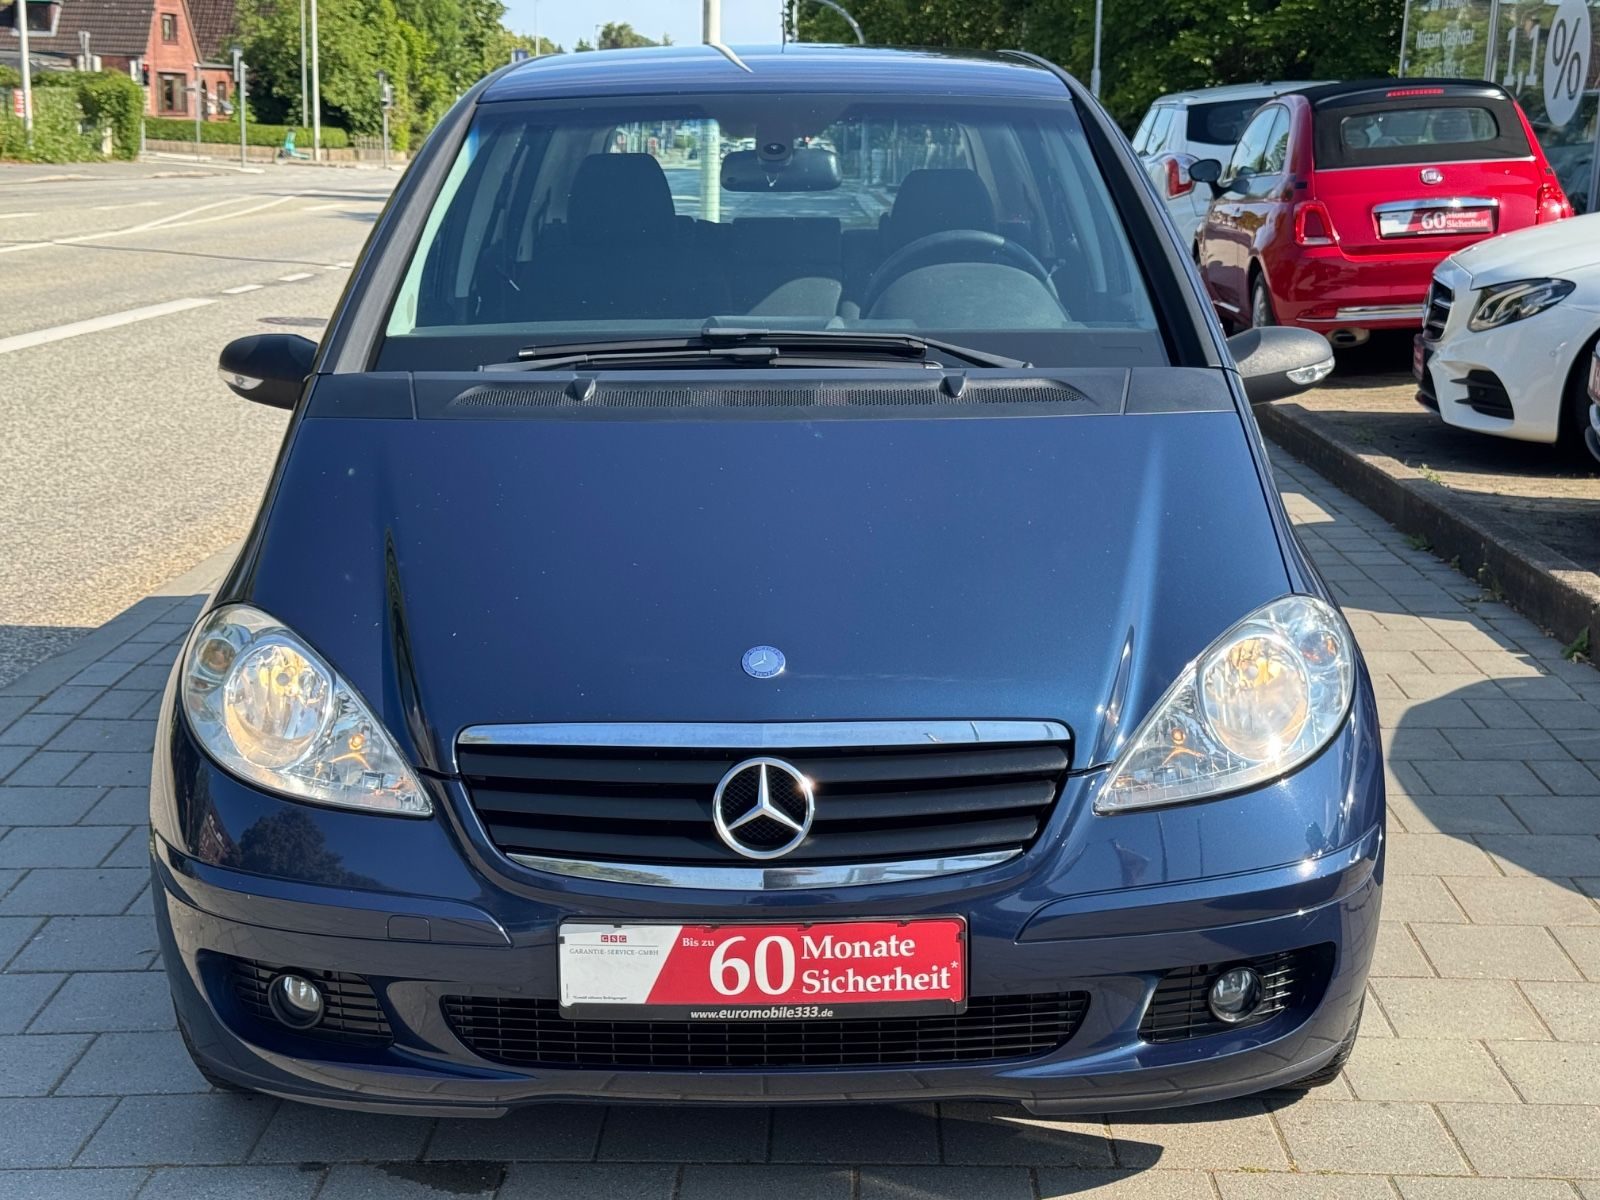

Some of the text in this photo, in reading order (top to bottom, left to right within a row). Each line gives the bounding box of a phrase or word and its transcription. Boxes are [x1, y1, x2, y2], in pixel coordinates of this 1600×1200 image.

[1552, 17, 1582, 100] %
[1421, 211, 1446, 230] 60
[682, 937, 699, 947] Bis
[800, 934, 916, 960] Monate
[709, 935, 796, 996] 60
[690, 1006, 834, 1019] www.euromobile333.de
